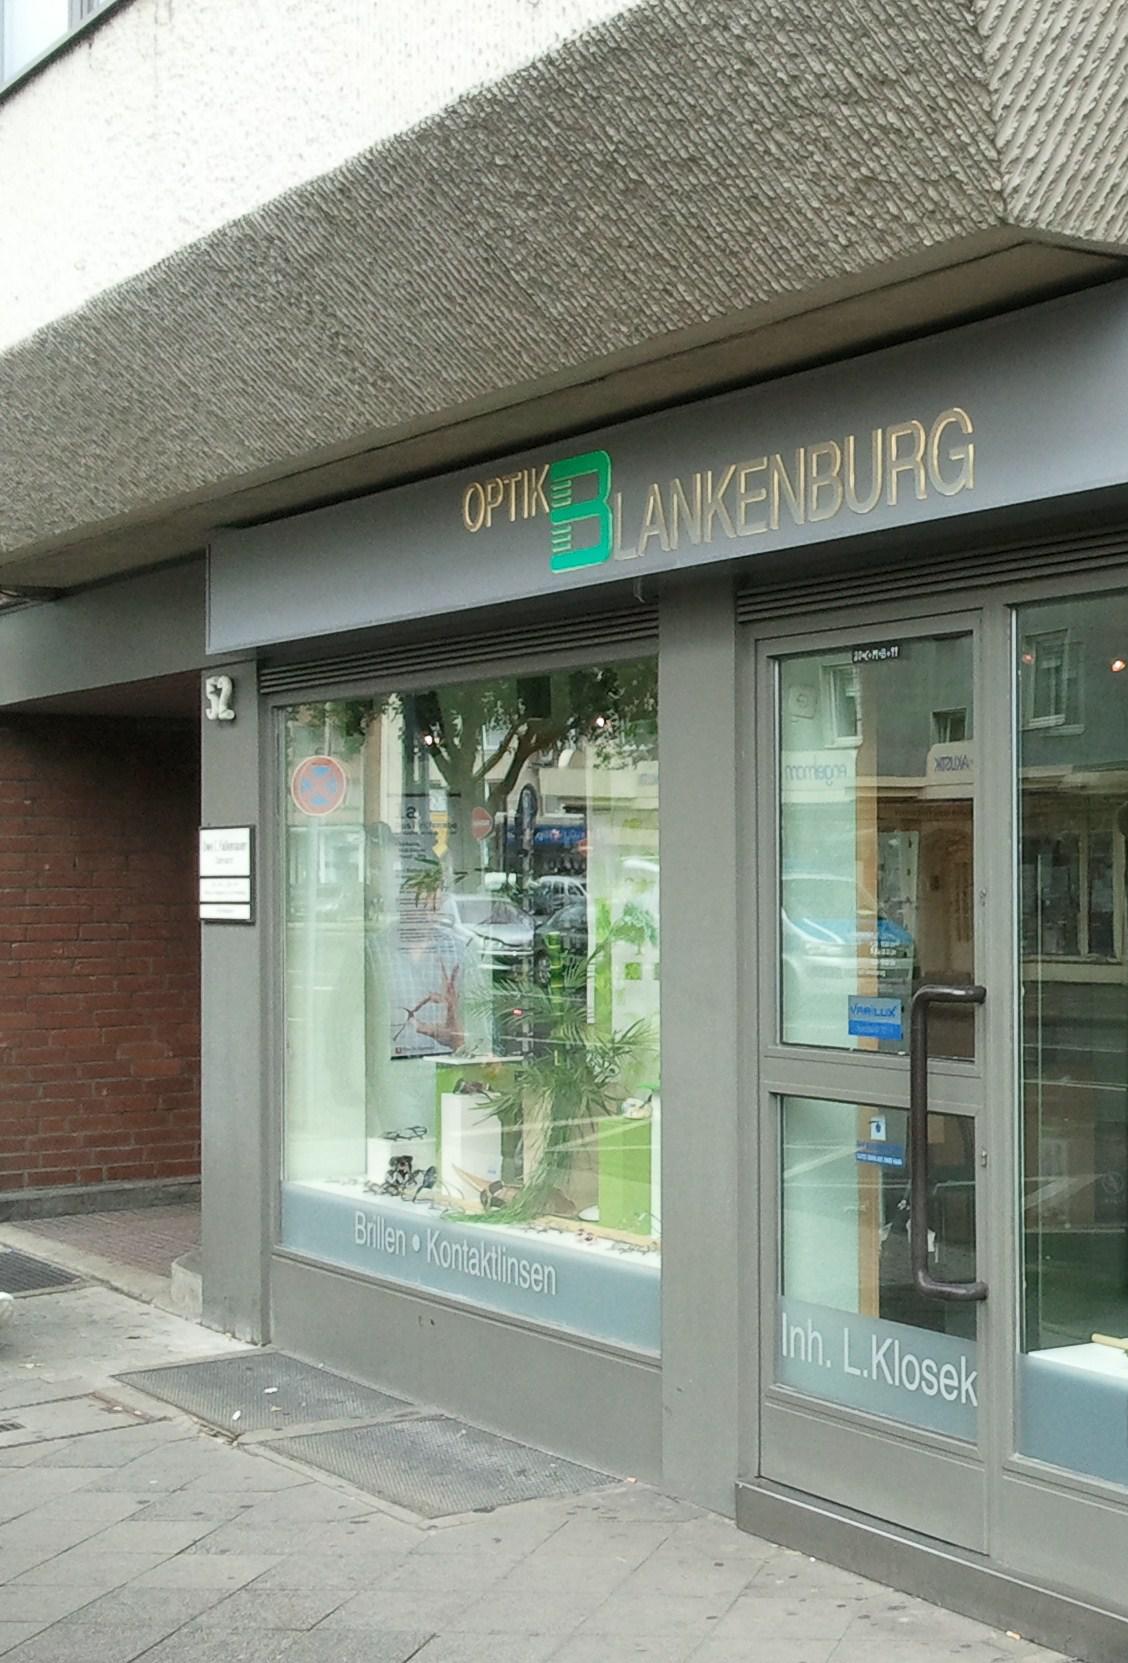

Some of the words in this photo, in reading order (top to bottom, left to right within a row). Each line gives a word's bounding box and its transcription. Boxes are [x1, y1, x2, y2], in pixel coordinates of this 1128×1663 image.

[462, 463, 551, 533] OPTIK
[549, 407, 975, 573] BLANKENBURG
[354, 1210, 406, 1257] Brillen
[426, 1228, 557, 1296] Kontaktlinsen
[781, 1311, 832, 1369] Inh.
